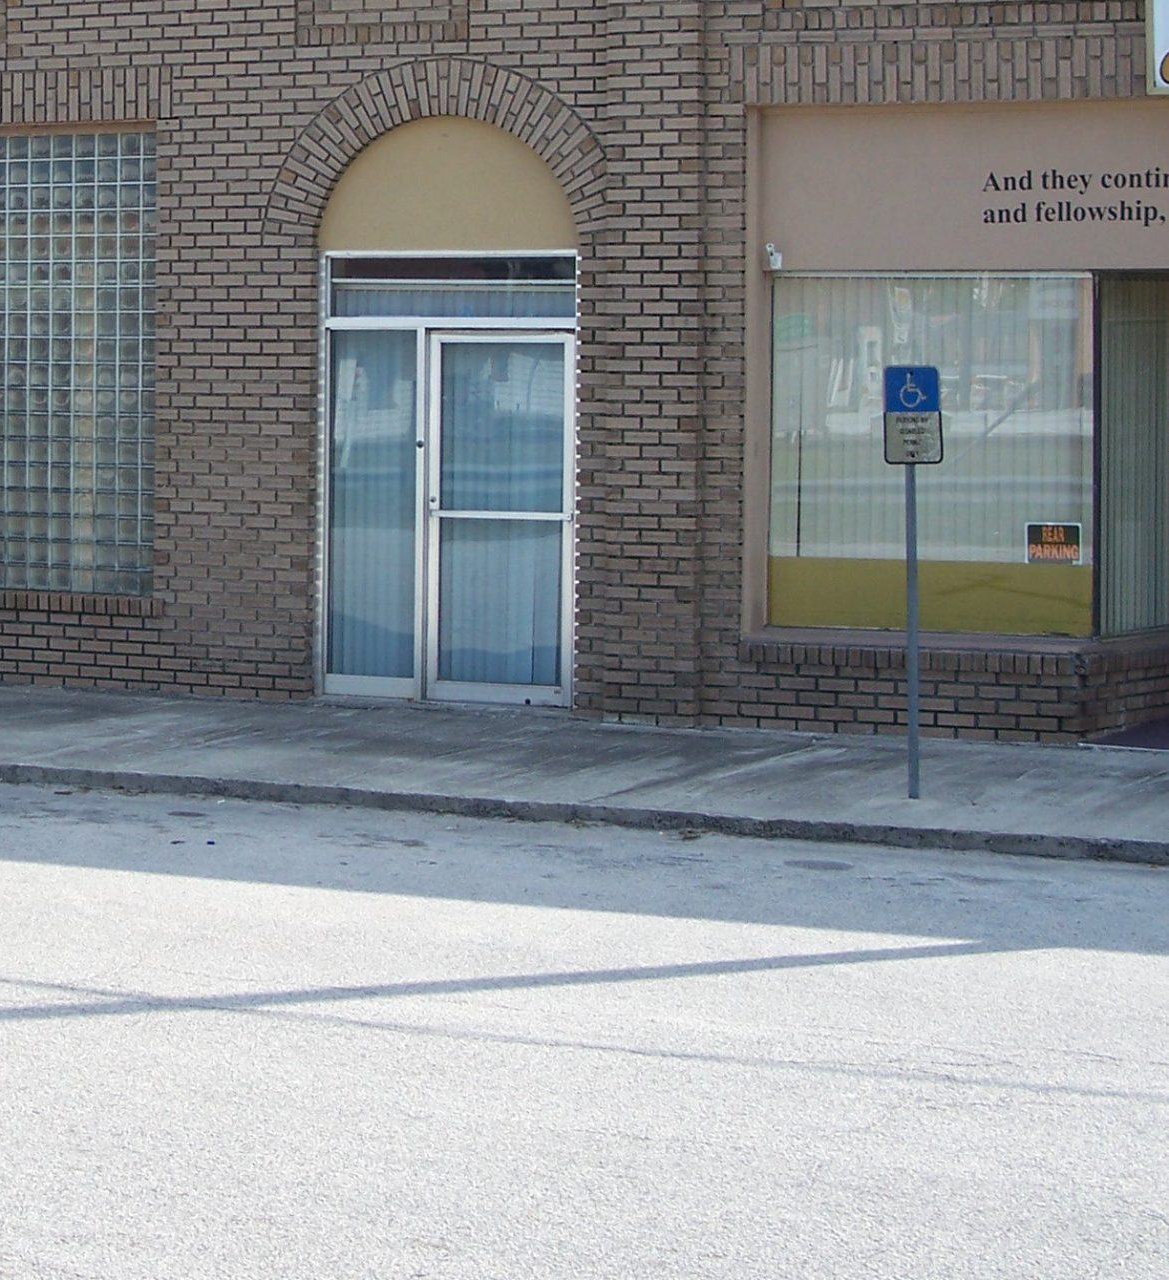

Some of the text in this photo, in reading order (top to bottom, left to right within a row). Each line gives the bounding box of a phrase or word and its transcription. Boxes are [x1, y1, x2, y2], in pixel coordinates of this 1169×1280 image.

[982, 170, 1033, 192] And
[1041, 169, 1093, 195] they
[983, 200, 1166, 227] and fellowship,
[1042, 526, 1065, 543] REAR
[1029, 543, 1079, 560] PARKING
